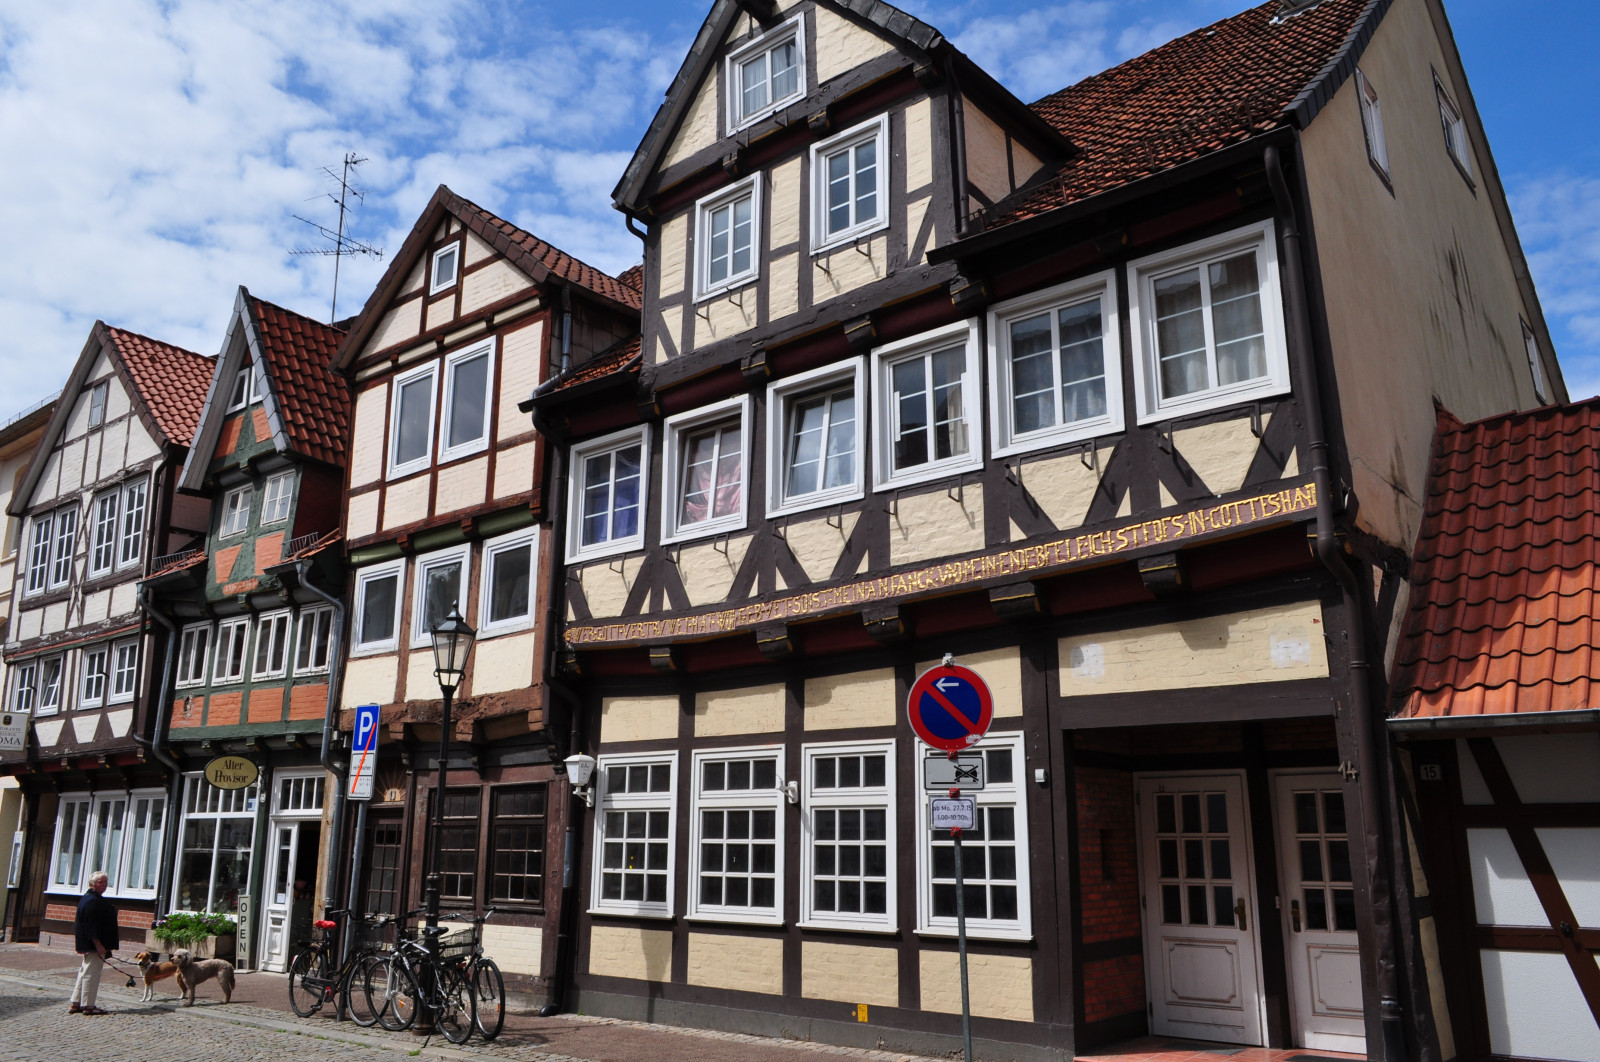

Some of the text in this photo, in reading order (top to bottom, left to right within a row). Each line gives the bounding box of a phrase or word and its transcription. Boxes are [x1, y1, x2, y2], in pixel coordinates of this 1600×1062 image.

[358, 711, 373, 746] P
[222, 759, 245, 770] Alter
[1338, 760, 1358, 780] 14
[1423, 765, 1437, 779] 15
[213, 770, 249, 783] Provisor
[239, 902, 248, 953] OPEN
